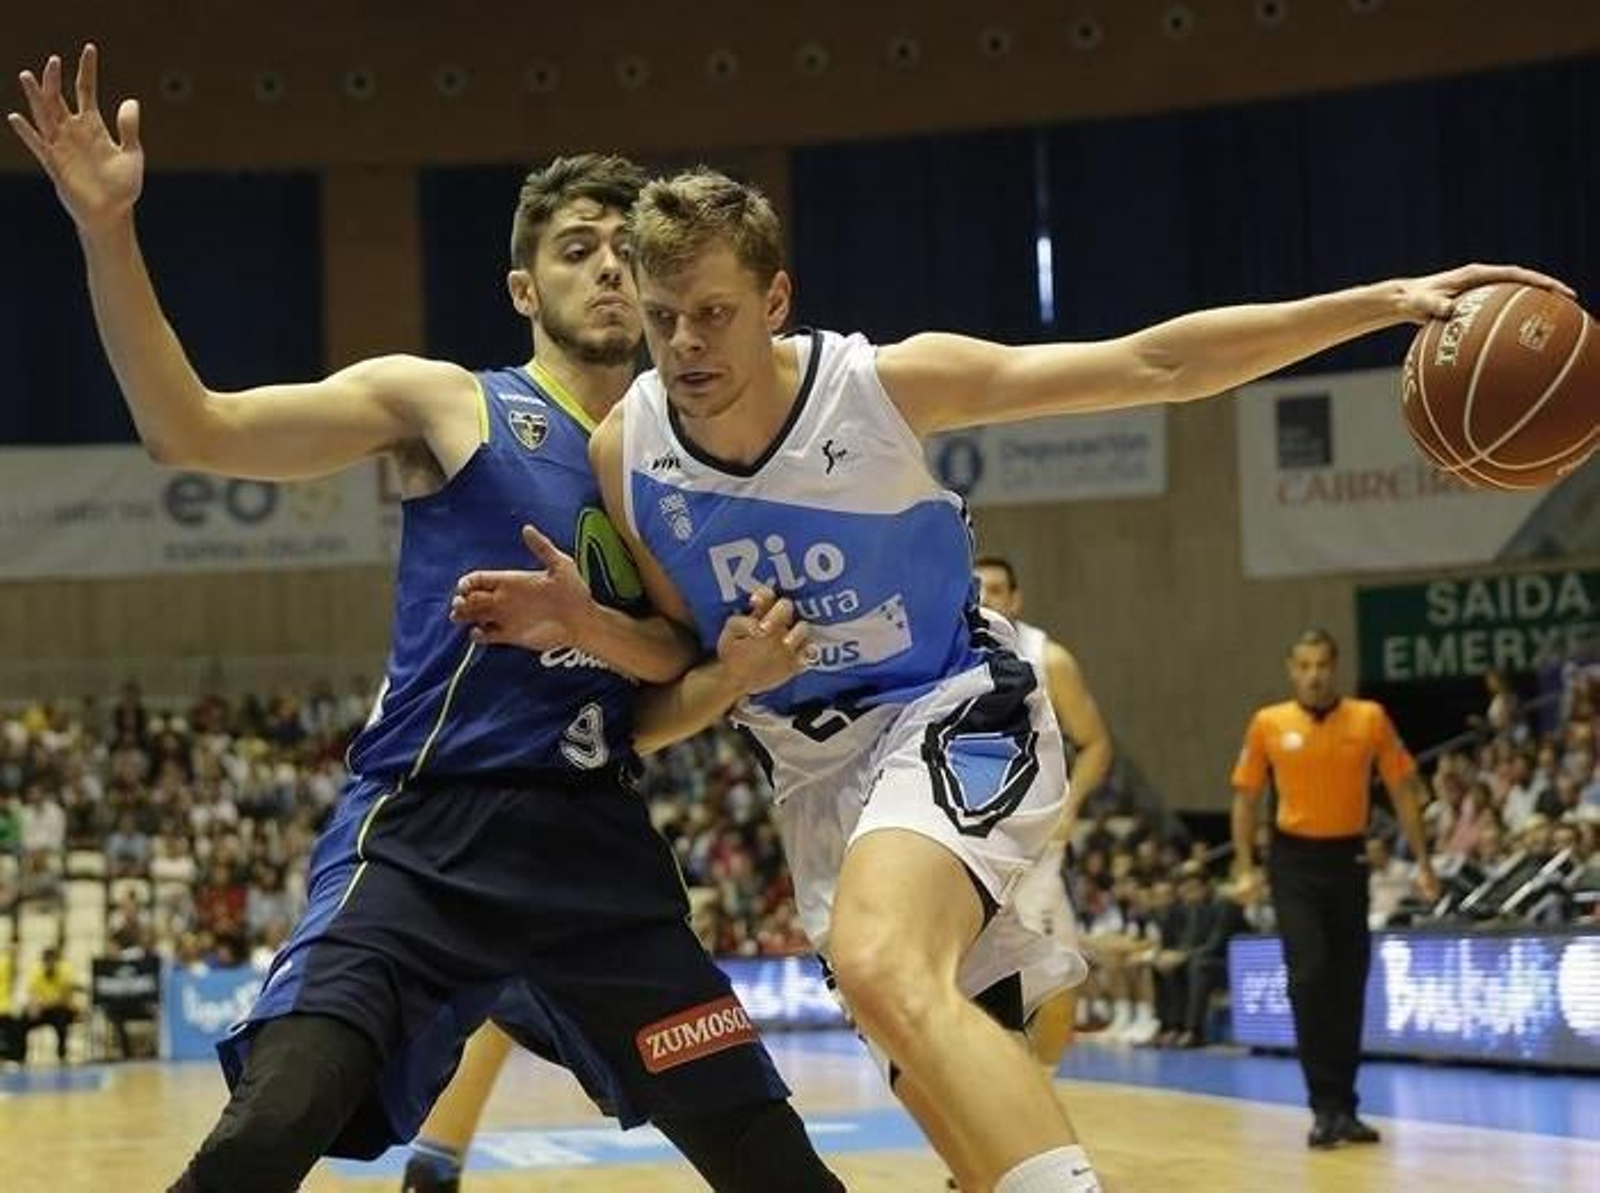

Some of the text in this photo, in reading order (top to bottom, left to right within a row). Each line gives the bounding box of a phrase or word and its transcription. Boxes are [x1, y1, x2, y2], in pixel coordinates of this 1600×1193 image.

[708, 534, 846, 604] Rio
[1425, 570, 1592, 628] SAIDA
[796, 588, 861, 620] ura
[559, 701, 611, 771] 9
